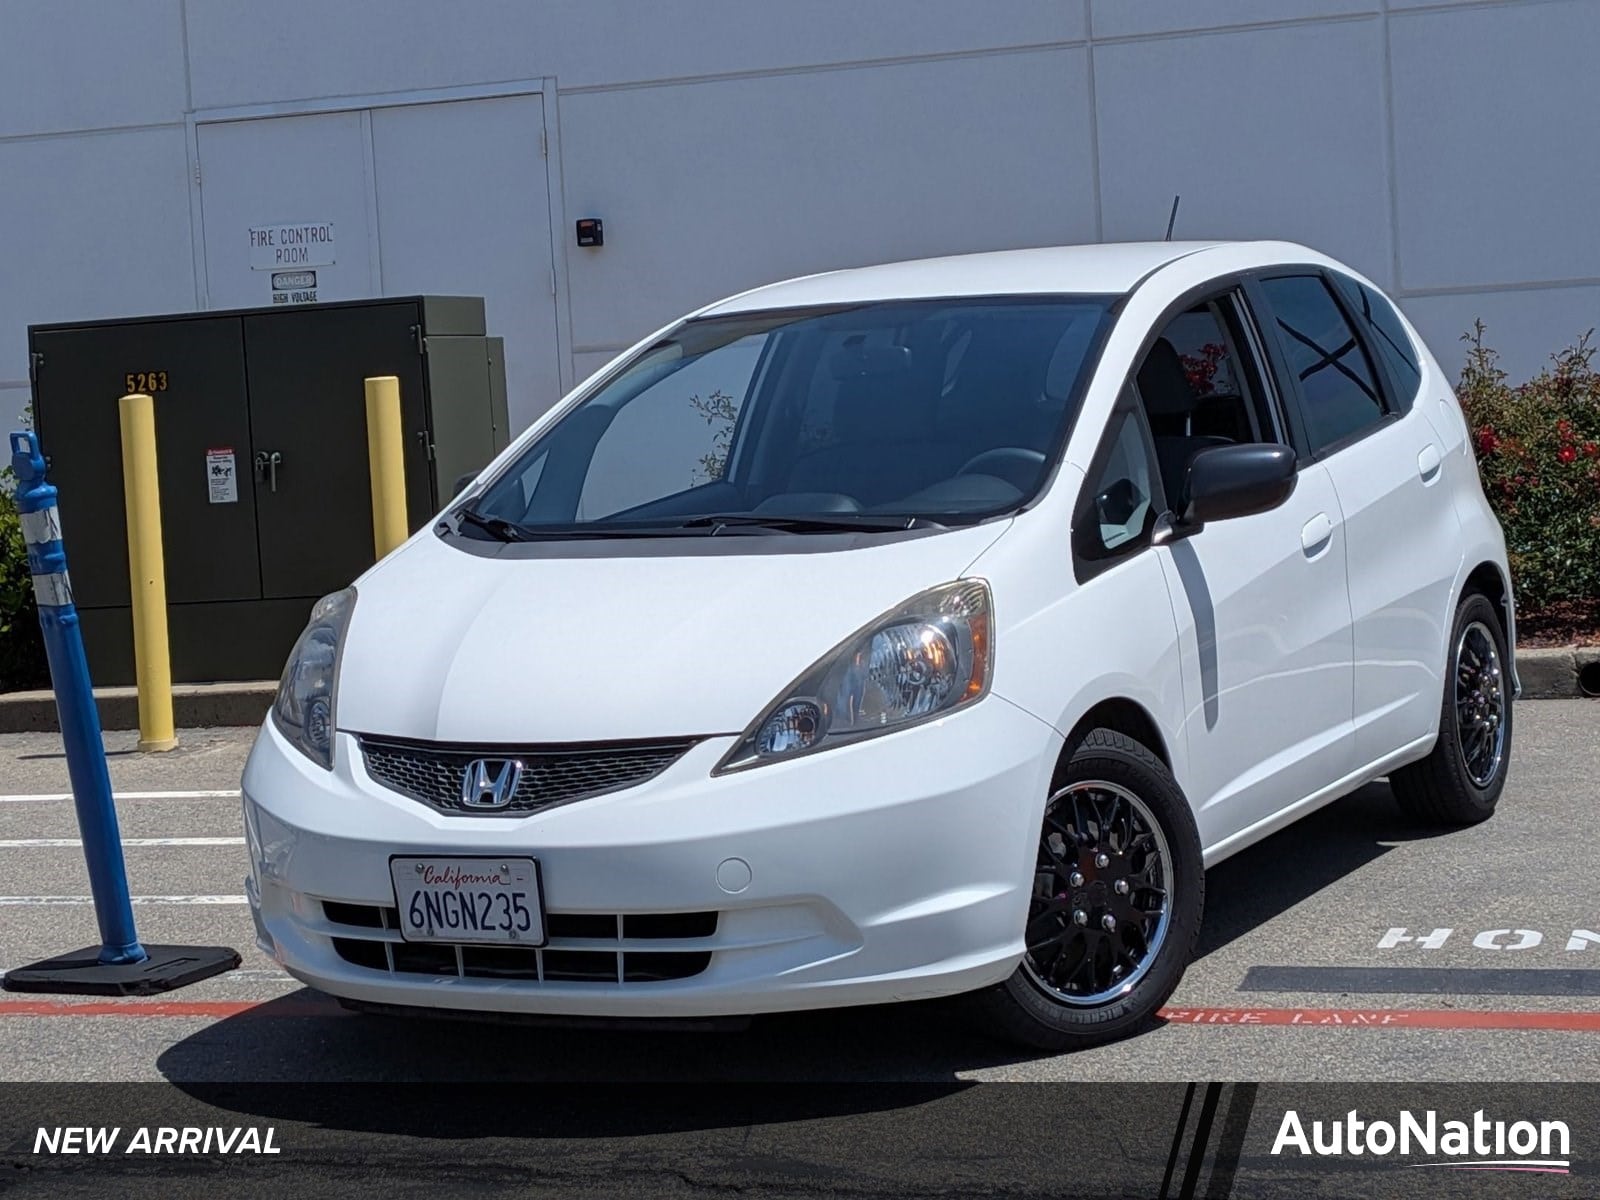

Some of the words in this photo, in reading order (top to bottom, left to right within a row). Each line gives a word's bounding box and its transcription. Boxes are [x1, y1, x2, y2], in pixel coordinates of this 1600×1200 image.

[250, 229, 275, 247] FIRE
[280, 226, 333, 245] CONTROL
[276, 247, 309, 264] ROOM
[291, 291, 317, 303] VOLTAGE
[126, 372, 168, 393] 5263
[424, 865, 511, 890] California
[409, 890, 531, 931] 6NGN235
[1165, 1012, 1267, 1023] FIRE
